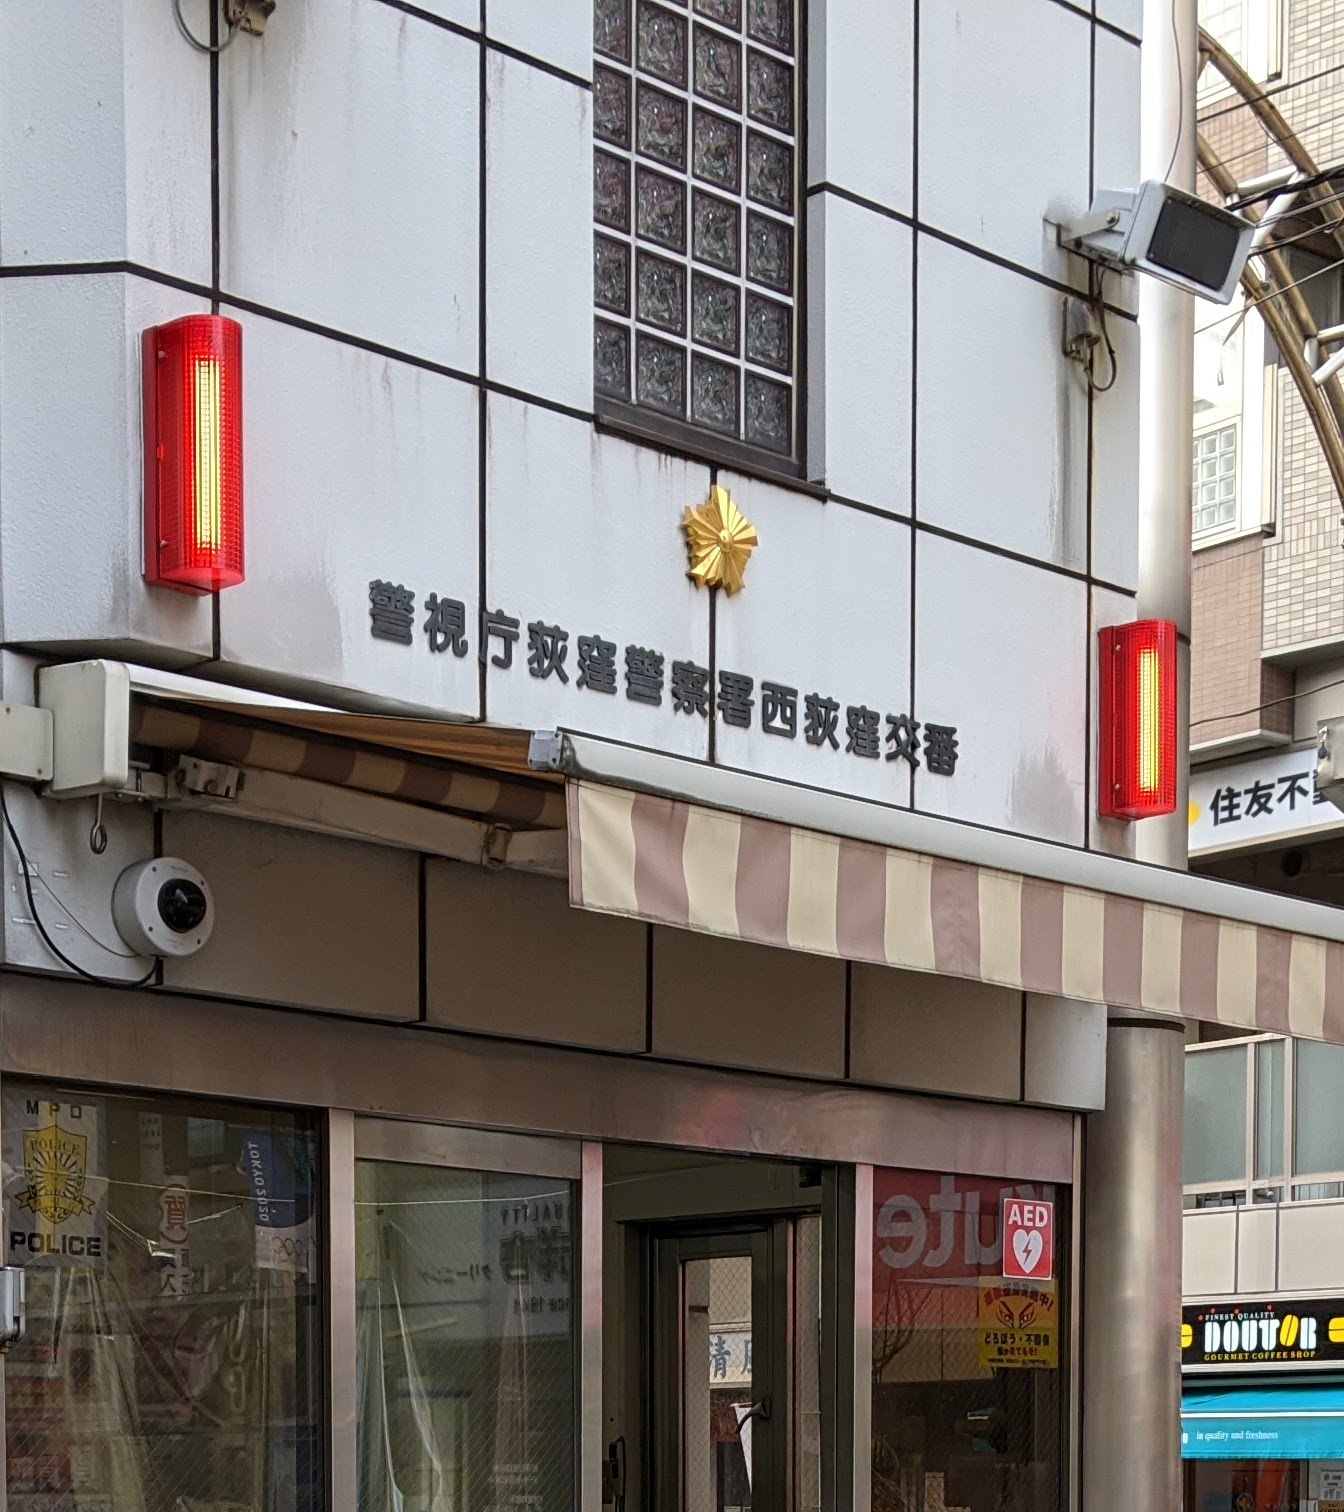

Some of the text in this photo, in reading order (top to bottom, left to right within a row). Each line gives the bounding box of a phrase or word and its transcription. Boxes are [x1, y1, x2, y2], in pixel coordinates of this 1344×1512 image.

[368, 578, 960, 776] 警視庁荻窪警察署西荻窪交番
[1008, 1204, 1048, 1228] AED
[10, 1231, 102, 1257] POLICE
[1238, 1311, 1275, 1320] QUALITY
[1204, 1314, 1316, 1352] DOUTOR
[1204, 1350, 1316, 1361] GOURMET COFFEE SHOP
[1230, 1431, 1244, 1440] and
